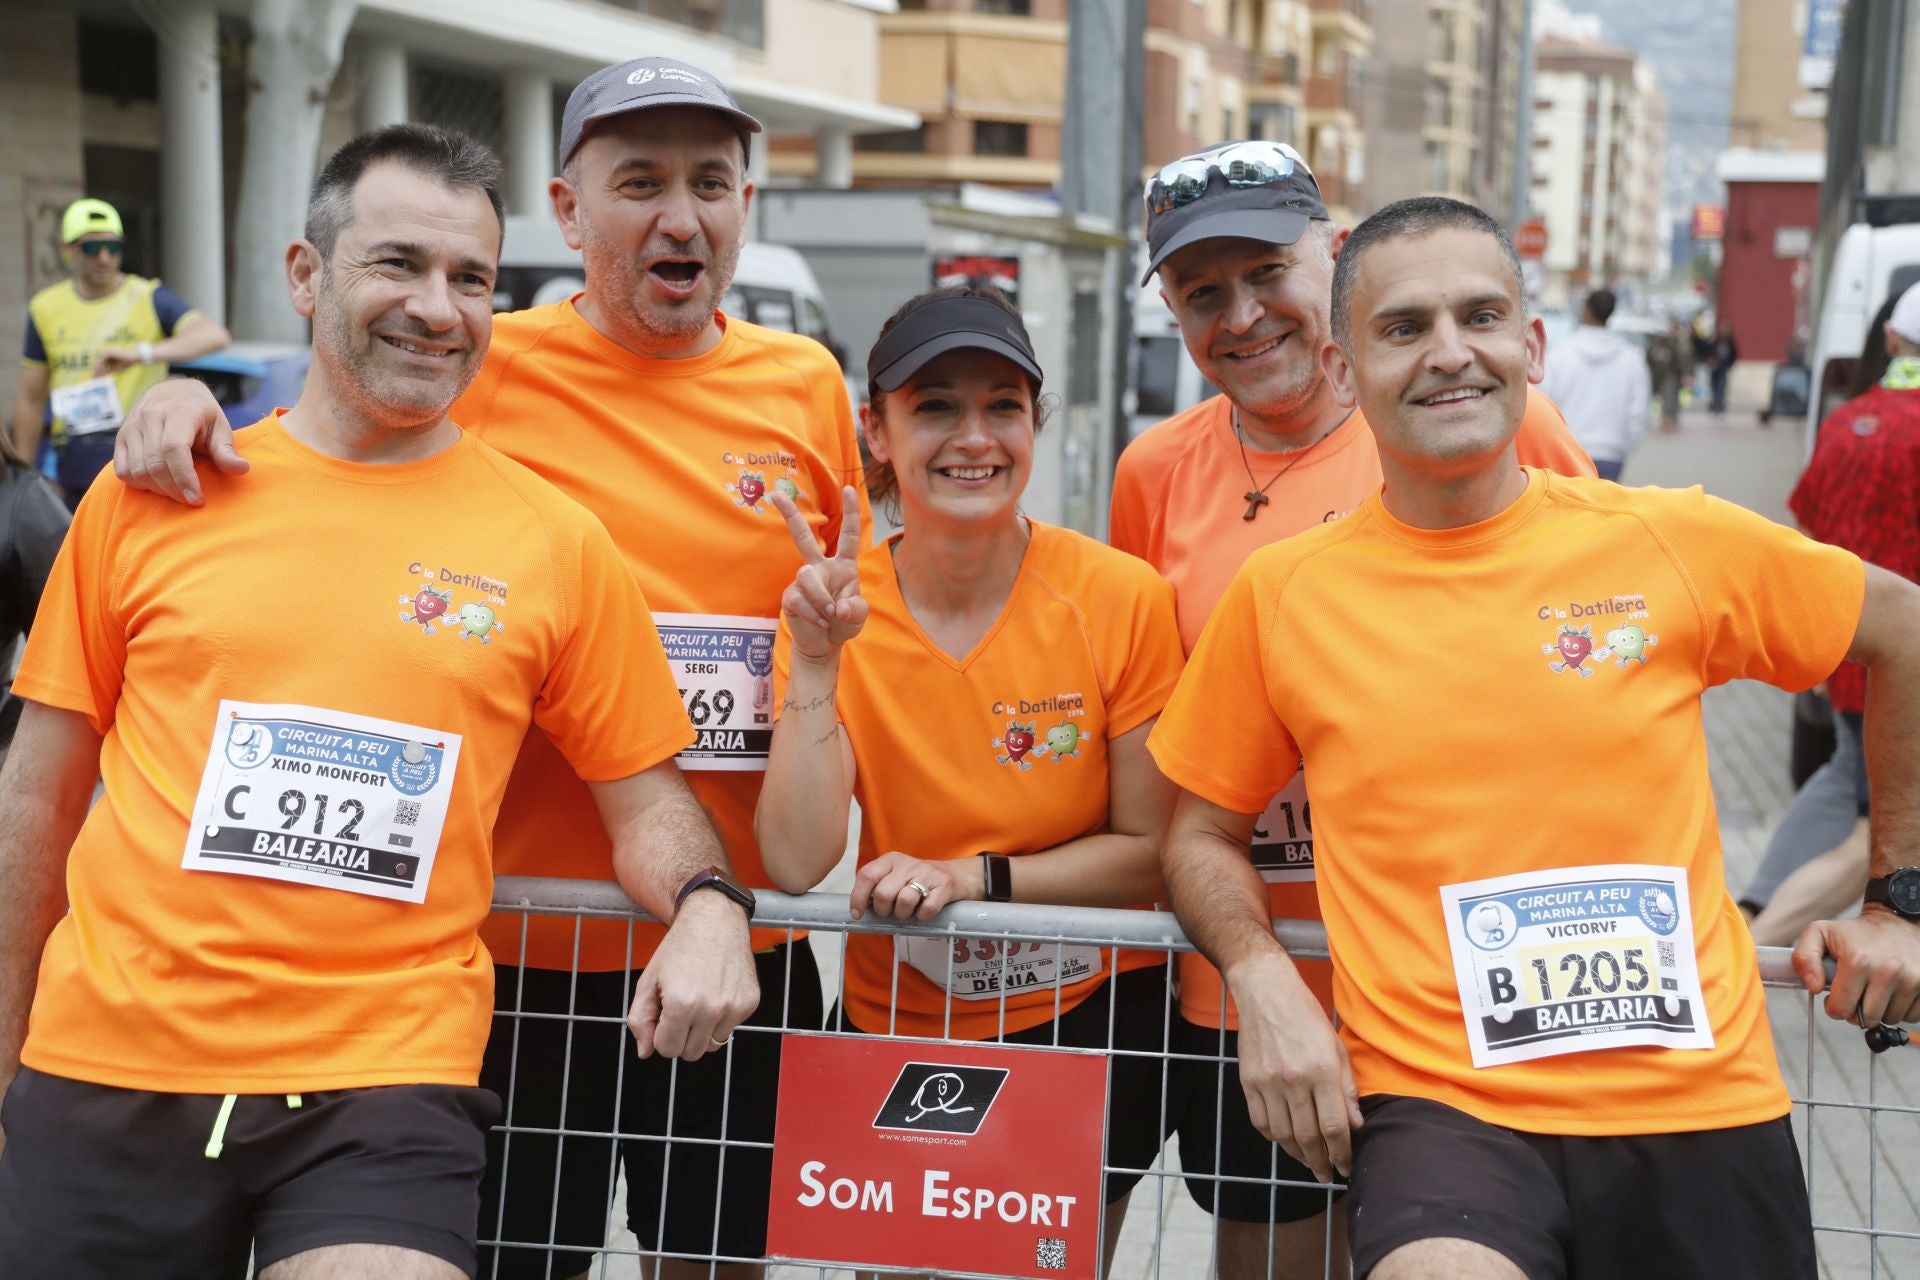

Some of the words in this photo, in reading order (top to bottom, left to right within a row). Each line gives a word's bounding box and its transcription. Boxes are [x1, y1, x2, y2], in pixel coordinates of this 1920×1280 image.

[748, 451, 796, 468] Datilera
[440, 568, 506, 598] Datilera
[1570, 598, 1646, 618] Datilera
[658, 634, 710, 646] CIRCUIT
[710, 636, 718, 646] A
[721, 636, 744, 647] PEU
[664, 647, 708, 658] MARINA
[711, 649, 738, 658] ALTA
[685, 663, 718, 674] SERGI
[1020, 696, 1083, 714] Datilera
[278, 728, 344, 748] CIRCUIT
[338, 737, 353, 749] A
[358, 739, 390, 755] PEU
[688, 731, 746, 750] ARIA
[286, 744, 340, 764] MARINA
[344, 752, 378, 768] ALTA
[271, 758, 312, 774] XIMO
[316, 766, 386, 788] MONFORT
[224, 784, 251, 820] C
[278, 789, 365, 842] 912
[1516, 891, 1582, 910] CIRCUIT
[1581, 890, 1594, 902] A
[1600, 888, 1631, 902] PEU
[1530, 906, 1586, 922] MARINA
[1590, 904, 1626, 915] ALTA
[1546, 920, 1617, 939] VICTORVF
[951, 936, 1041, 964] 33
[957, 971, 988, 979] VOLTA
[1014, 964, 1032, 972] PEU
[984, 958, 1014, 968] ENIO
[973, 972, 1038, 992] DÉNIA
[1487, 967, 1517, 1005] B
[1531, 949, 1649, 1001] 1205
[878, 1132, 967, 1146] www.somesport.com
